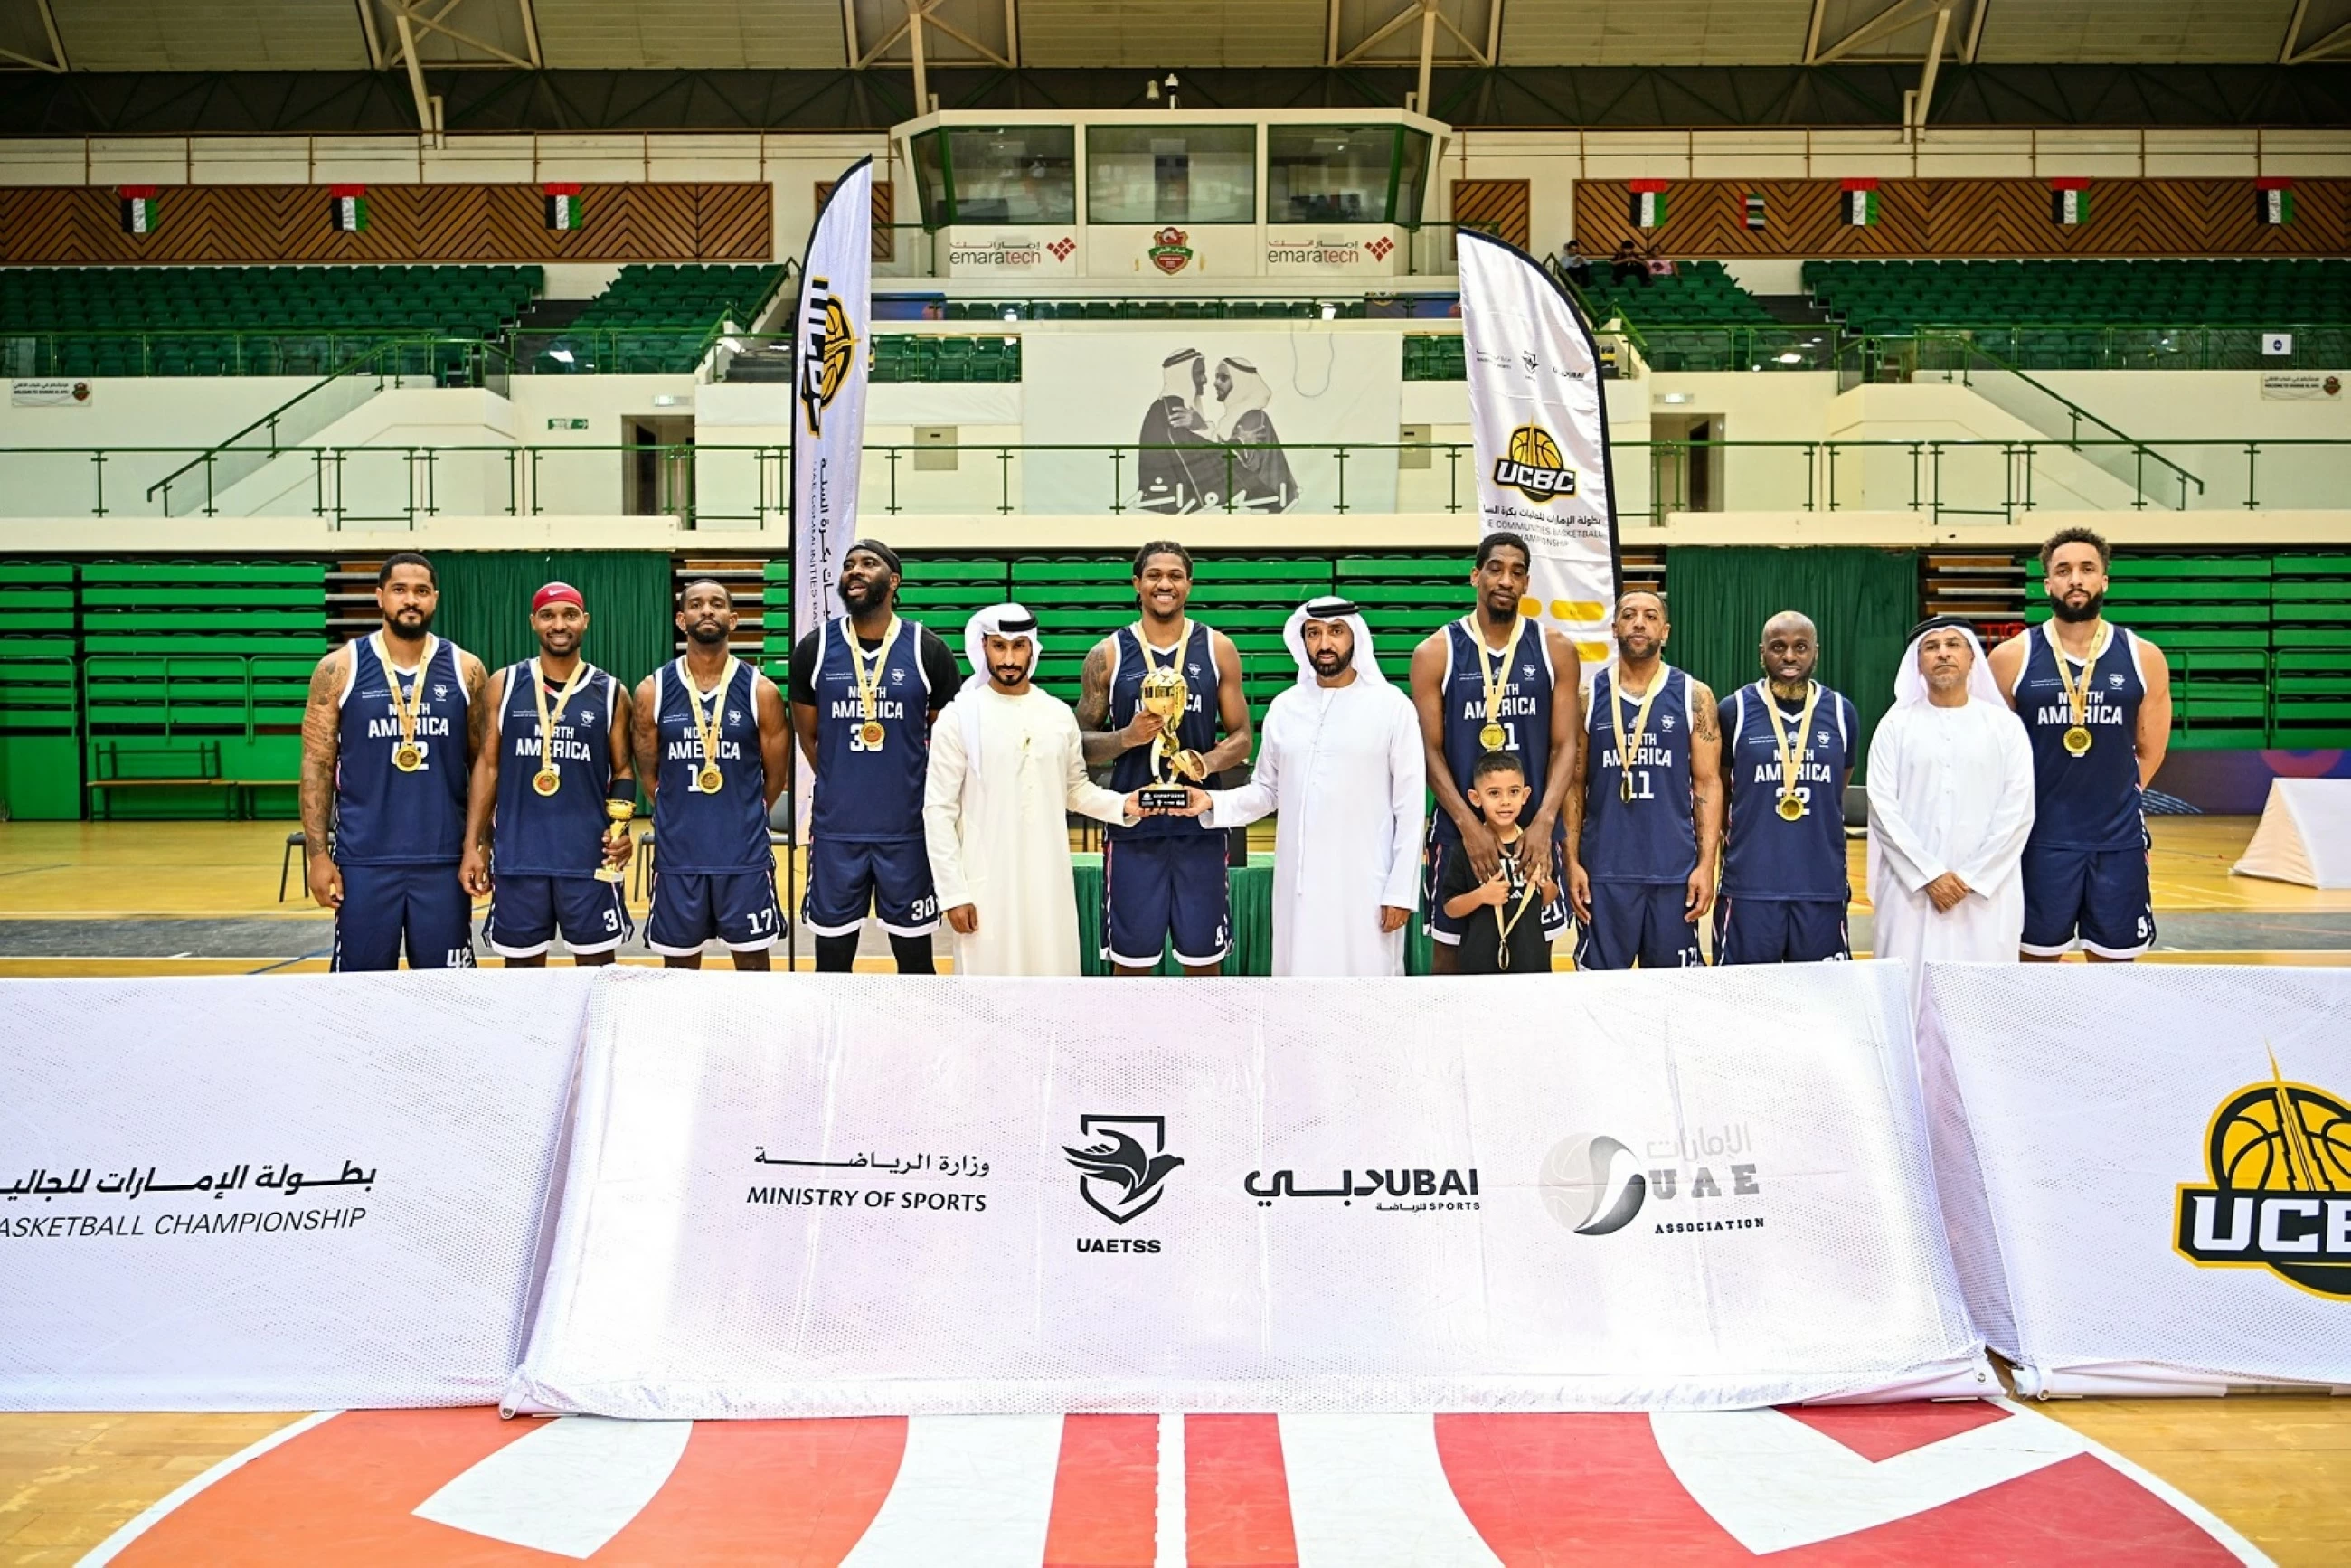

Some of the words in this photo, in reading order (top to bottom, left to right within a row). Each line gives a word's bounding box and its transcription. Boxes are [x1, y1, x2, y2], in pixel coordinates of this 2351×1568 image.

[949, 251, 1041, 264] emaratech
[1268, 250, 1359, 263] emaratech
[1497, 460, 1575, 492] UCBC
[831, 700, 904, 720] AMEICA
[2058, 690, 2104, 704] NTH
[534, 724, 575, 740] NRTH
[850, 723, 883, 752] 3
[1487, 722, 1520, 752] 1
[668, 741, 741, 760] AMEICA
[687, 763, 721, 792] 1
[1753, 763, 1832, 784] AMRICA
[602, 909, 619, 932] 3
[911, 894, 936, 921] 30
[746, 907, 773, 935] 17
[1646, 1121, 1752, 1163] الإمارات
[754, 1146, 931, 1175] الرياضة
[939, 1153, 990, 1177] وزارة
[0, 1168, 91, 1202] للجالي
[95, 1164, 250, 1200] الإمارات
[255, 1160, 377, 1196] بطولة
[1648, 1163, 1760, 1200] UAE
[746, 1186, 859, 1207] MINISTRY
[864, 1189, 896, 1208] OF
[901, 1191, 987, 1212] SPORTS
[1430, 1202, 1480, 1211] SPORTS
[0, 1214, 145, 1238] ASKETBALL
[154, 1206, 366, 1236] CHAMPIONSHIP
[1654, 1217, 1764, 1234] ASSOCIATION
[1076, 1237, 1162, 1254] UAETSS
